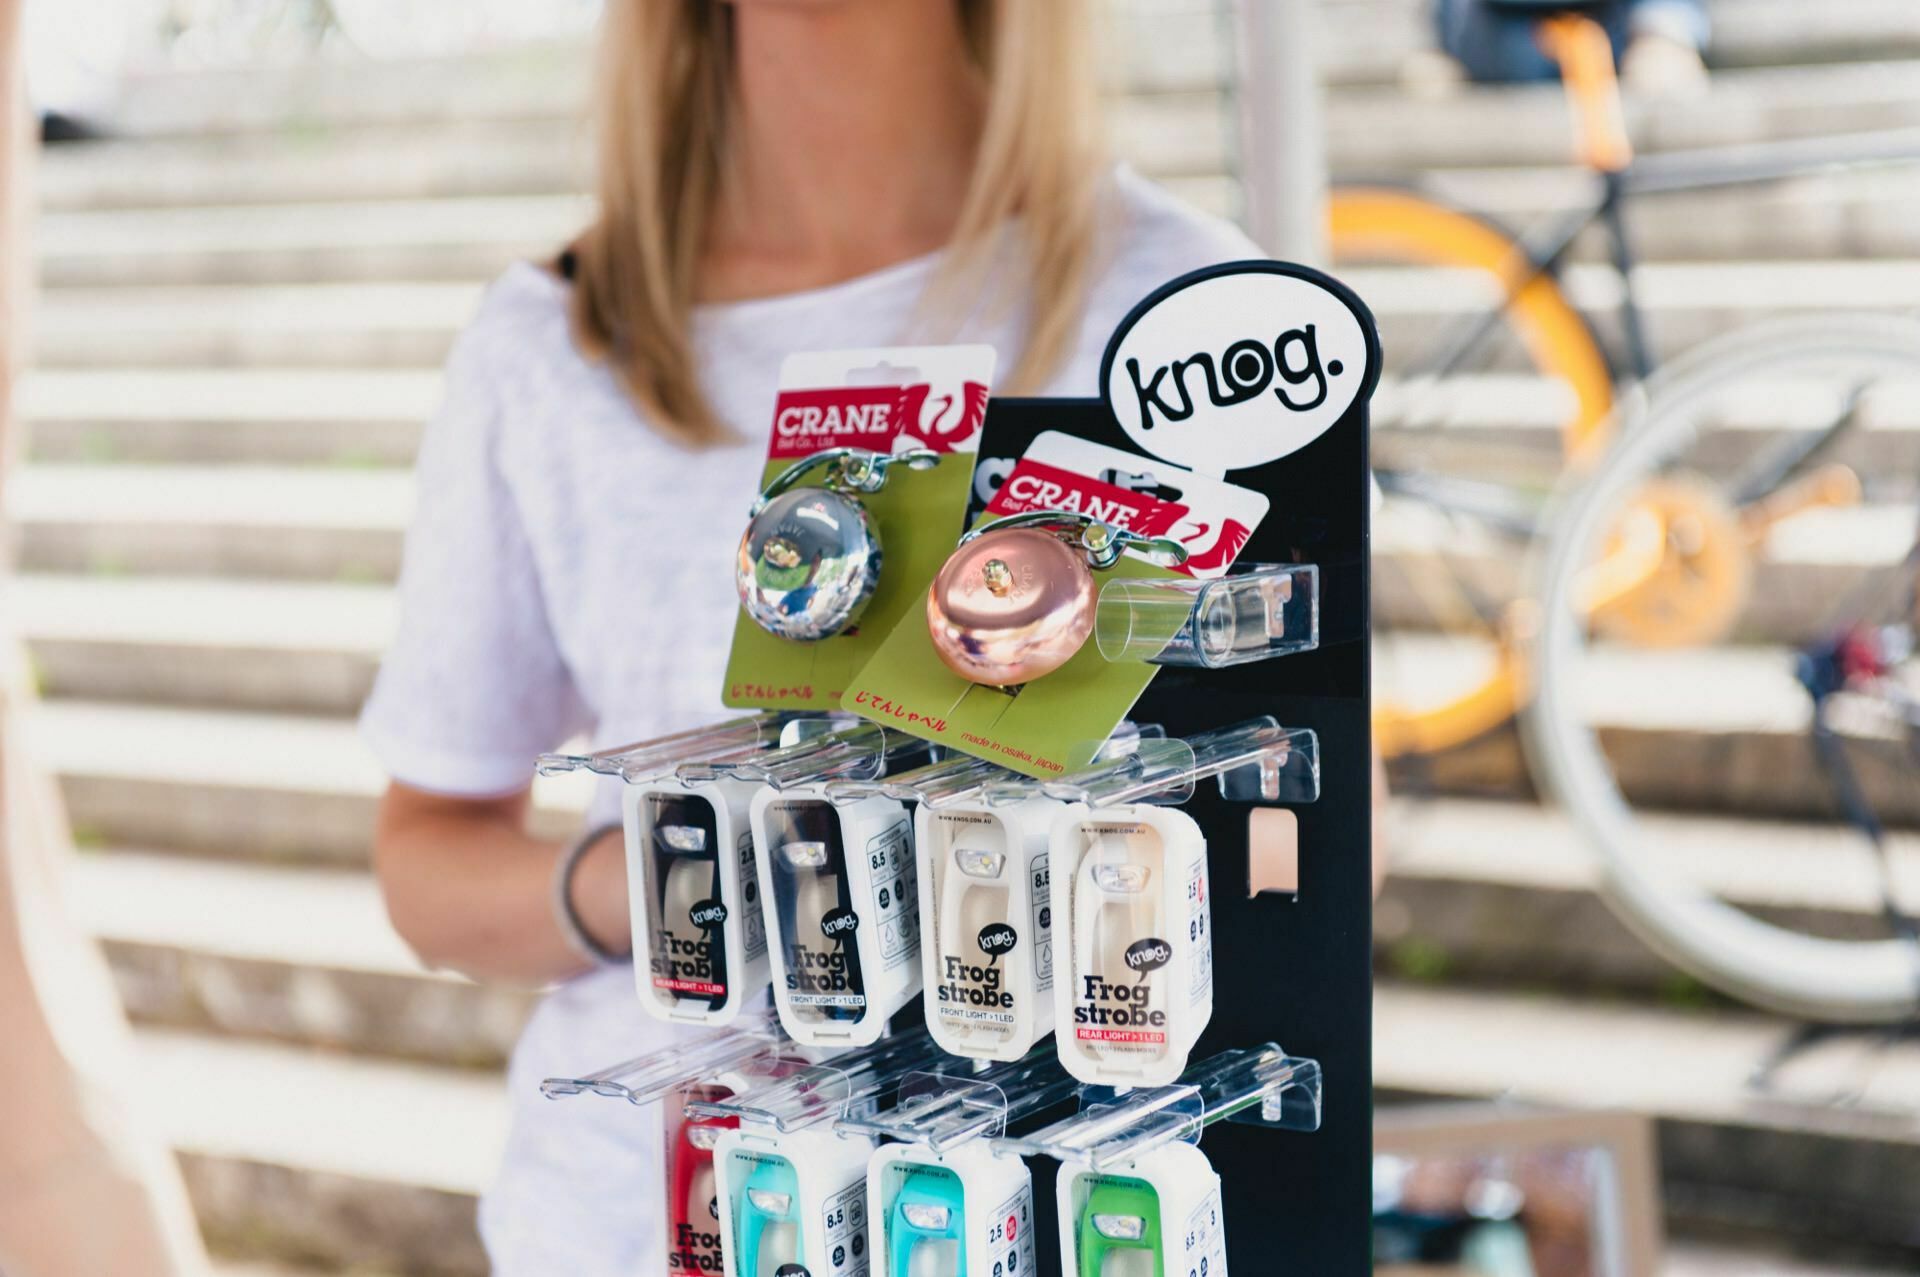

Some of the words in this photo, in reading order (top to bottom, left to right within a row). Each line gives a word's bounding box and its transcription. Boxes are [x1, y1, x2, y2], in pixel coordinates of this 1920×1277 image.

[1125, 323, 1344, 430] knog.
[777, 404, 891, 437] CRANE
[1001, 497, 1024, 511] Bell
[1009, 475, 1139, 530] CRANE
[855, 691, 948, 732] じてんしゃベル
[960, 731, 989, 747] made
[990, 741, 1001, 751] in
[1001, 746, 1033, 764] osaka,
[1034, 758, 1065, 774] japan
[871, 851, 886, 870] 8.5
[691, 906, 725, 925] knog.
[822, 914, 857, 935] knog.
[657, 929, 712, 962] Frog
[979, 930, 1015, 949] knog.
[651, 954, 713, 978] strob
[792, 943, 846, 973] Frog
[1126, 945, 1169, 967] knog.
[786, 969, 853, 991] strob
[945, 954, 1000, 990] Frog
[675, 981, 698, 991] LIGHT
[938, 981, 1014, 1008] strobe
[1083, 975, 1152, 1008] Frog
[790, 996, 813, 1004] FRONT
[815, 996, 837, 1005] LIGHT
[848, 997, 864, 1005] LED
[940, 1007, 964, 1017] FRONT
[965, 1011, 988, 1020] LIGHT
[999, 1014, 1015, 1023] LED
[1074, 1002, 1167, 1027] strobe
[1079, 1030, 1103, 1039] REAR
[1104, 1031, 1130, 1041] LIGHT
[1145, 1034, 1163, 1042] LED
[827, 1209, 844, 1229] 8.5
[990, 1223, 1003, 1243] 2.5
